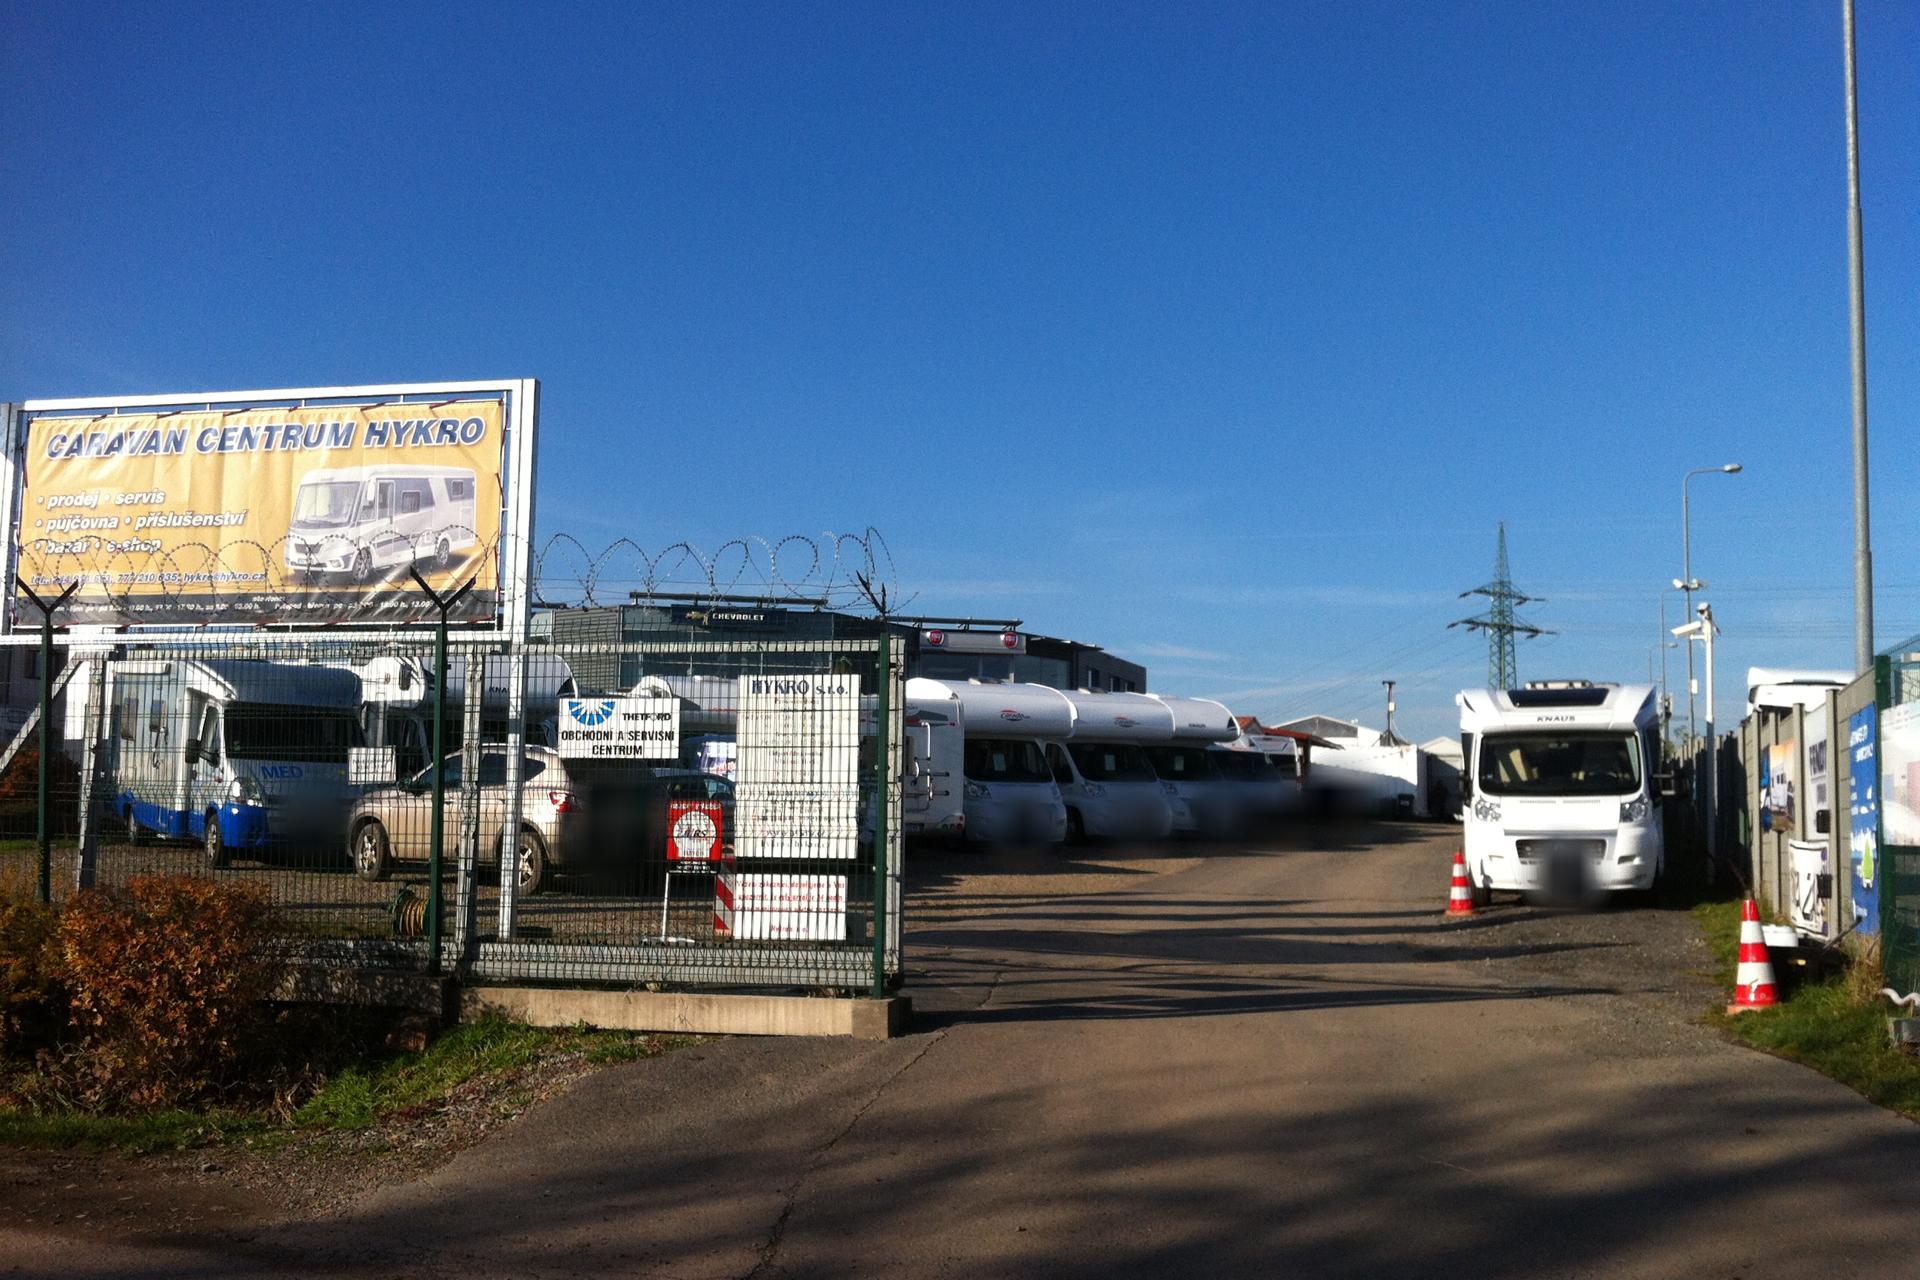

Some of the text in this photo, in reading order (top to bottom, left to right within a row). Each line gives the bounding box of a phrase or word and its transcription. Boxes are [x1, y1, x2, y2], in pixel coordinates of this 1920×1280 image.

[47, 417, 486, 459] CARAVAN CENTRUM HYKRO
[47, 489, 166, 510] prodej servis
[135, 509, 248, 531] příslušenství
[712, 613, 765, 621] CHEVROLET
[752, 679, 810, 695] HYKRO
[622, 712, 672, 721] THETFORD
[561, 727, 675, 741] OBCHODNÍ A SERVISNÍ
[592, 744, 643, 756] CENTRUM
[261, 765, 304, 778] MED
